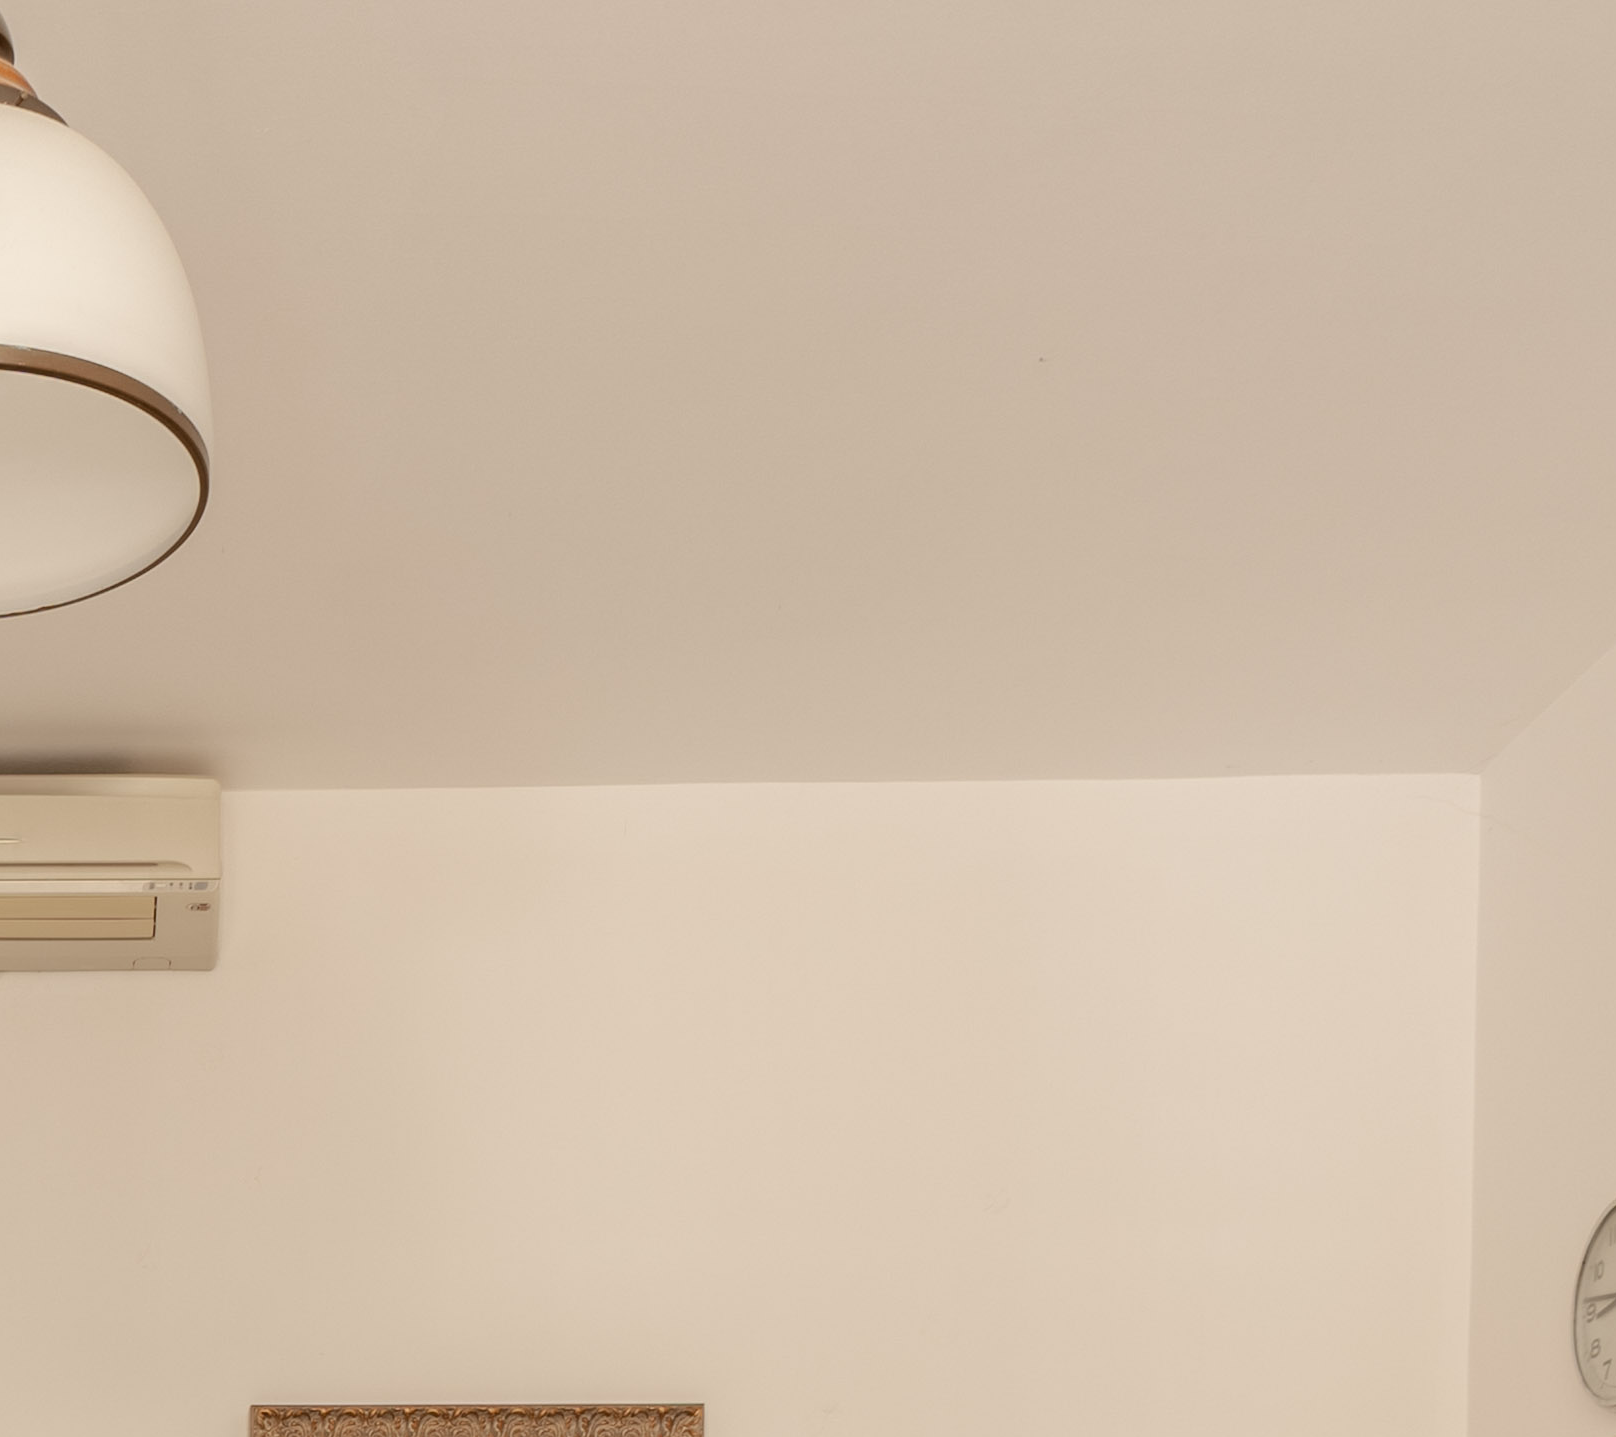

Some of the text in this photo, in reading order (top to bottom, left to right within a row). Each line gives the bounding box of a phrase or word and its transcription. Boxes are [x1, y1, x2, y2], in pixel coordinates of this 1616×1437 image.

[1593, 1259, 1604, 1282] 10
[1586, 1302, 1596, 1323] 9
[1590, 1338, 1601, 1358] 8
[1602, 1359, 1612, 1380] 7
